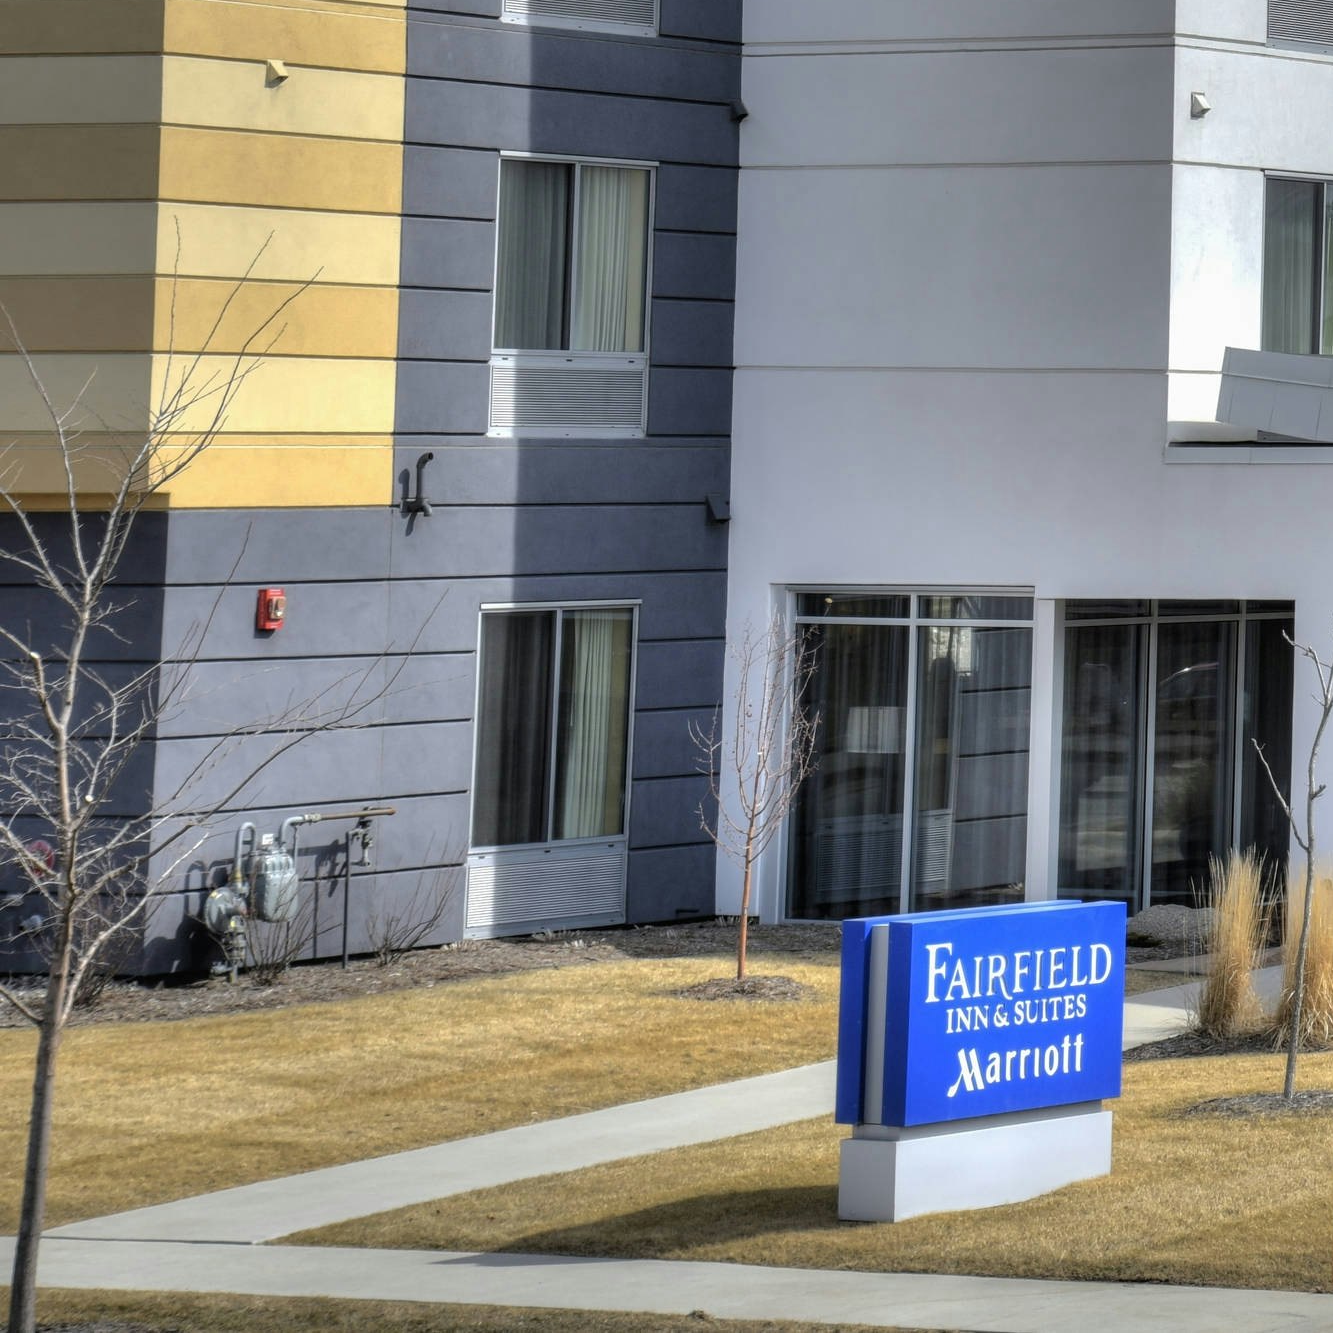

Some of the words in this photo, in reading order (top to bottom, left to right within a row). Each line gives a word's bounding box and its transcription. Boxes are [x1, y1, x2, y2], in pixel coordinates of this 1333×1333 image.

[924, 942, 1112, 1003] FAIRFIELD
[946, 1005, 989, 1034] INN
[993, 1004, 1010, 1027] &
[1014, 994, 1087, 1026] SUITES
[946, 1033, 1084, 1097] Marriott
